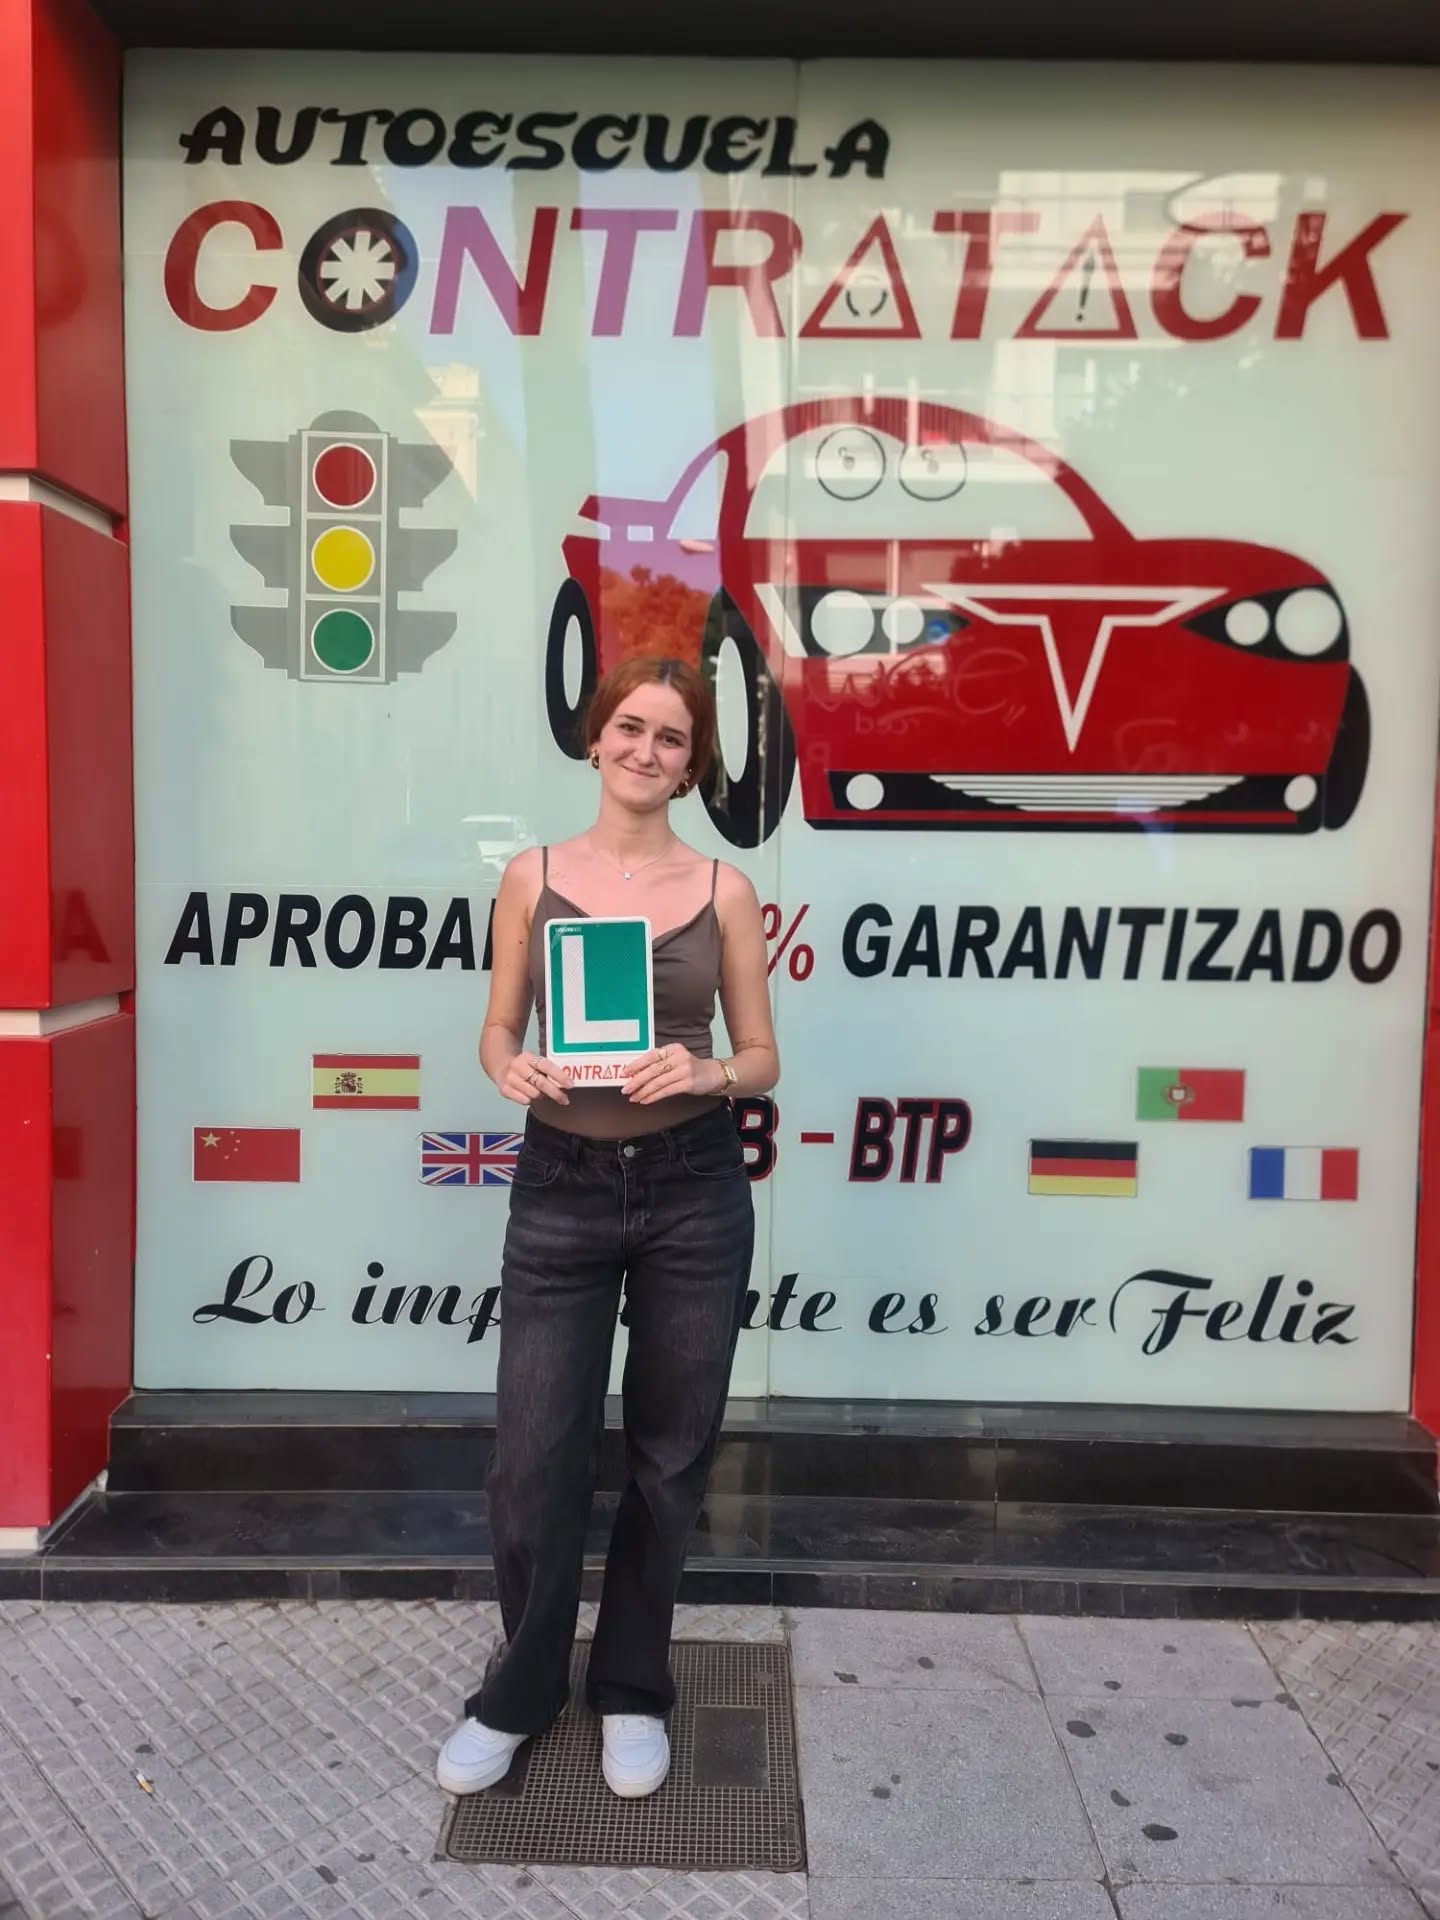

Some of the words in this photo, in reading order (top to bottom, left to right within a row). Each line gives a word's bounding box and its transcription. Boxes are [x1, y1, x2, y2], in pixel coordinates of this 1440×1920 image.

[179, 106, 889, 179] AUTOESCUELA
[164, 200, 1409, 343] CONTRATACK
[561, 935, 640, 1044] L
[842, 902, 1402, 984] GARANTIZADO
[848, 1097, 972, 1183] BTP
[193, 1255, 326, 1324] Lo
[868, 1290, 948, 1334] es
[974, 1293, 1097, 1337] ser
[1110, 1268, 1358, 1355] Feliz
